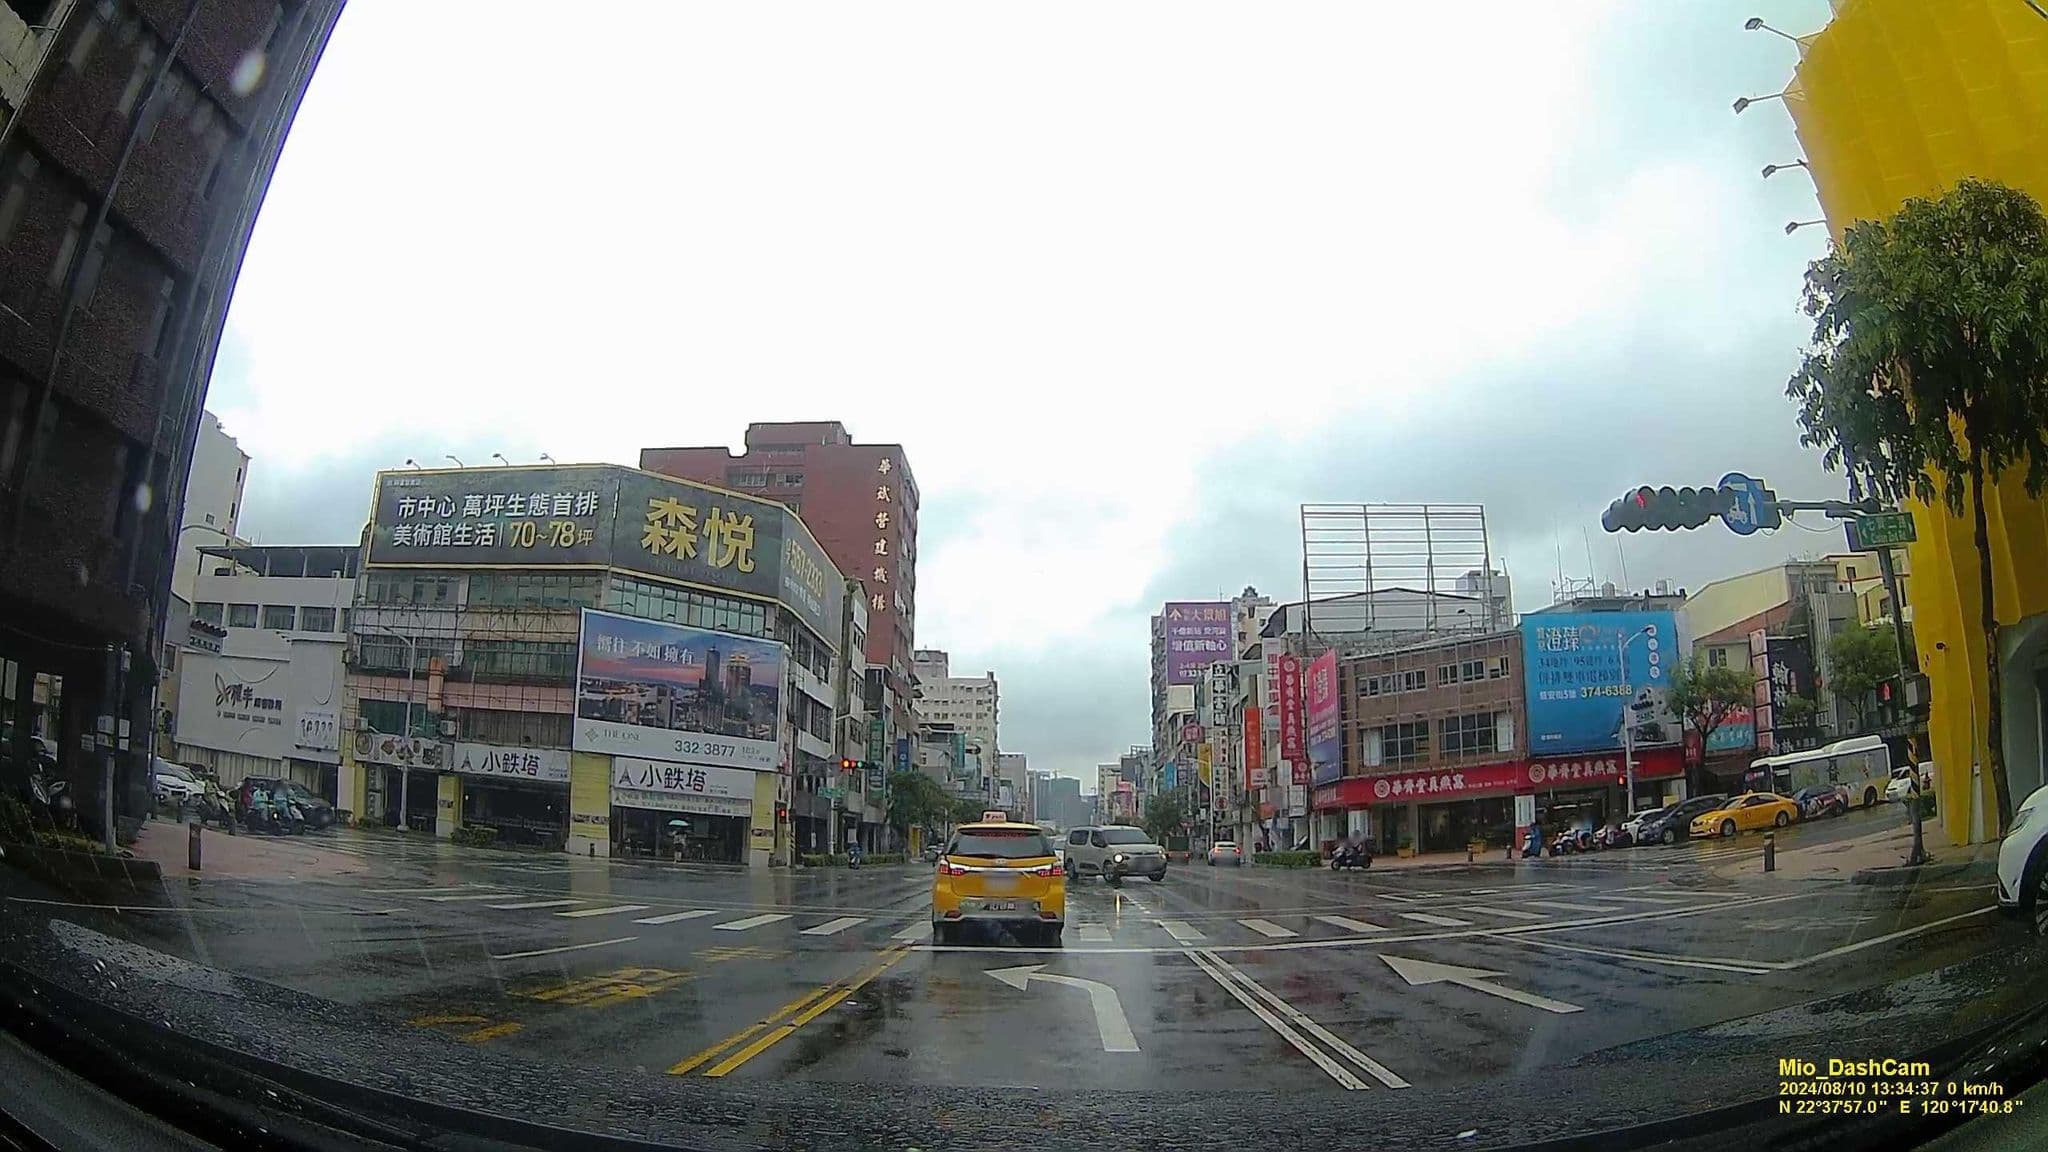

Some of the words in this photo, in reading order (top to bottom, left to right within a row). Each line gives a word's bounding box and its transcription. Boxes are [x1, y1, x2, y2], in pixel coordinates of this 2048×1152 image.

[397, 496, 456, 519] 市中心
[462, 491, 600, 518] 萬坪生態首排
[392, 522, 495, 547] 美術館生活
[674, 740, 699, 754] 332
[703, 742, 736, 758] 3877
